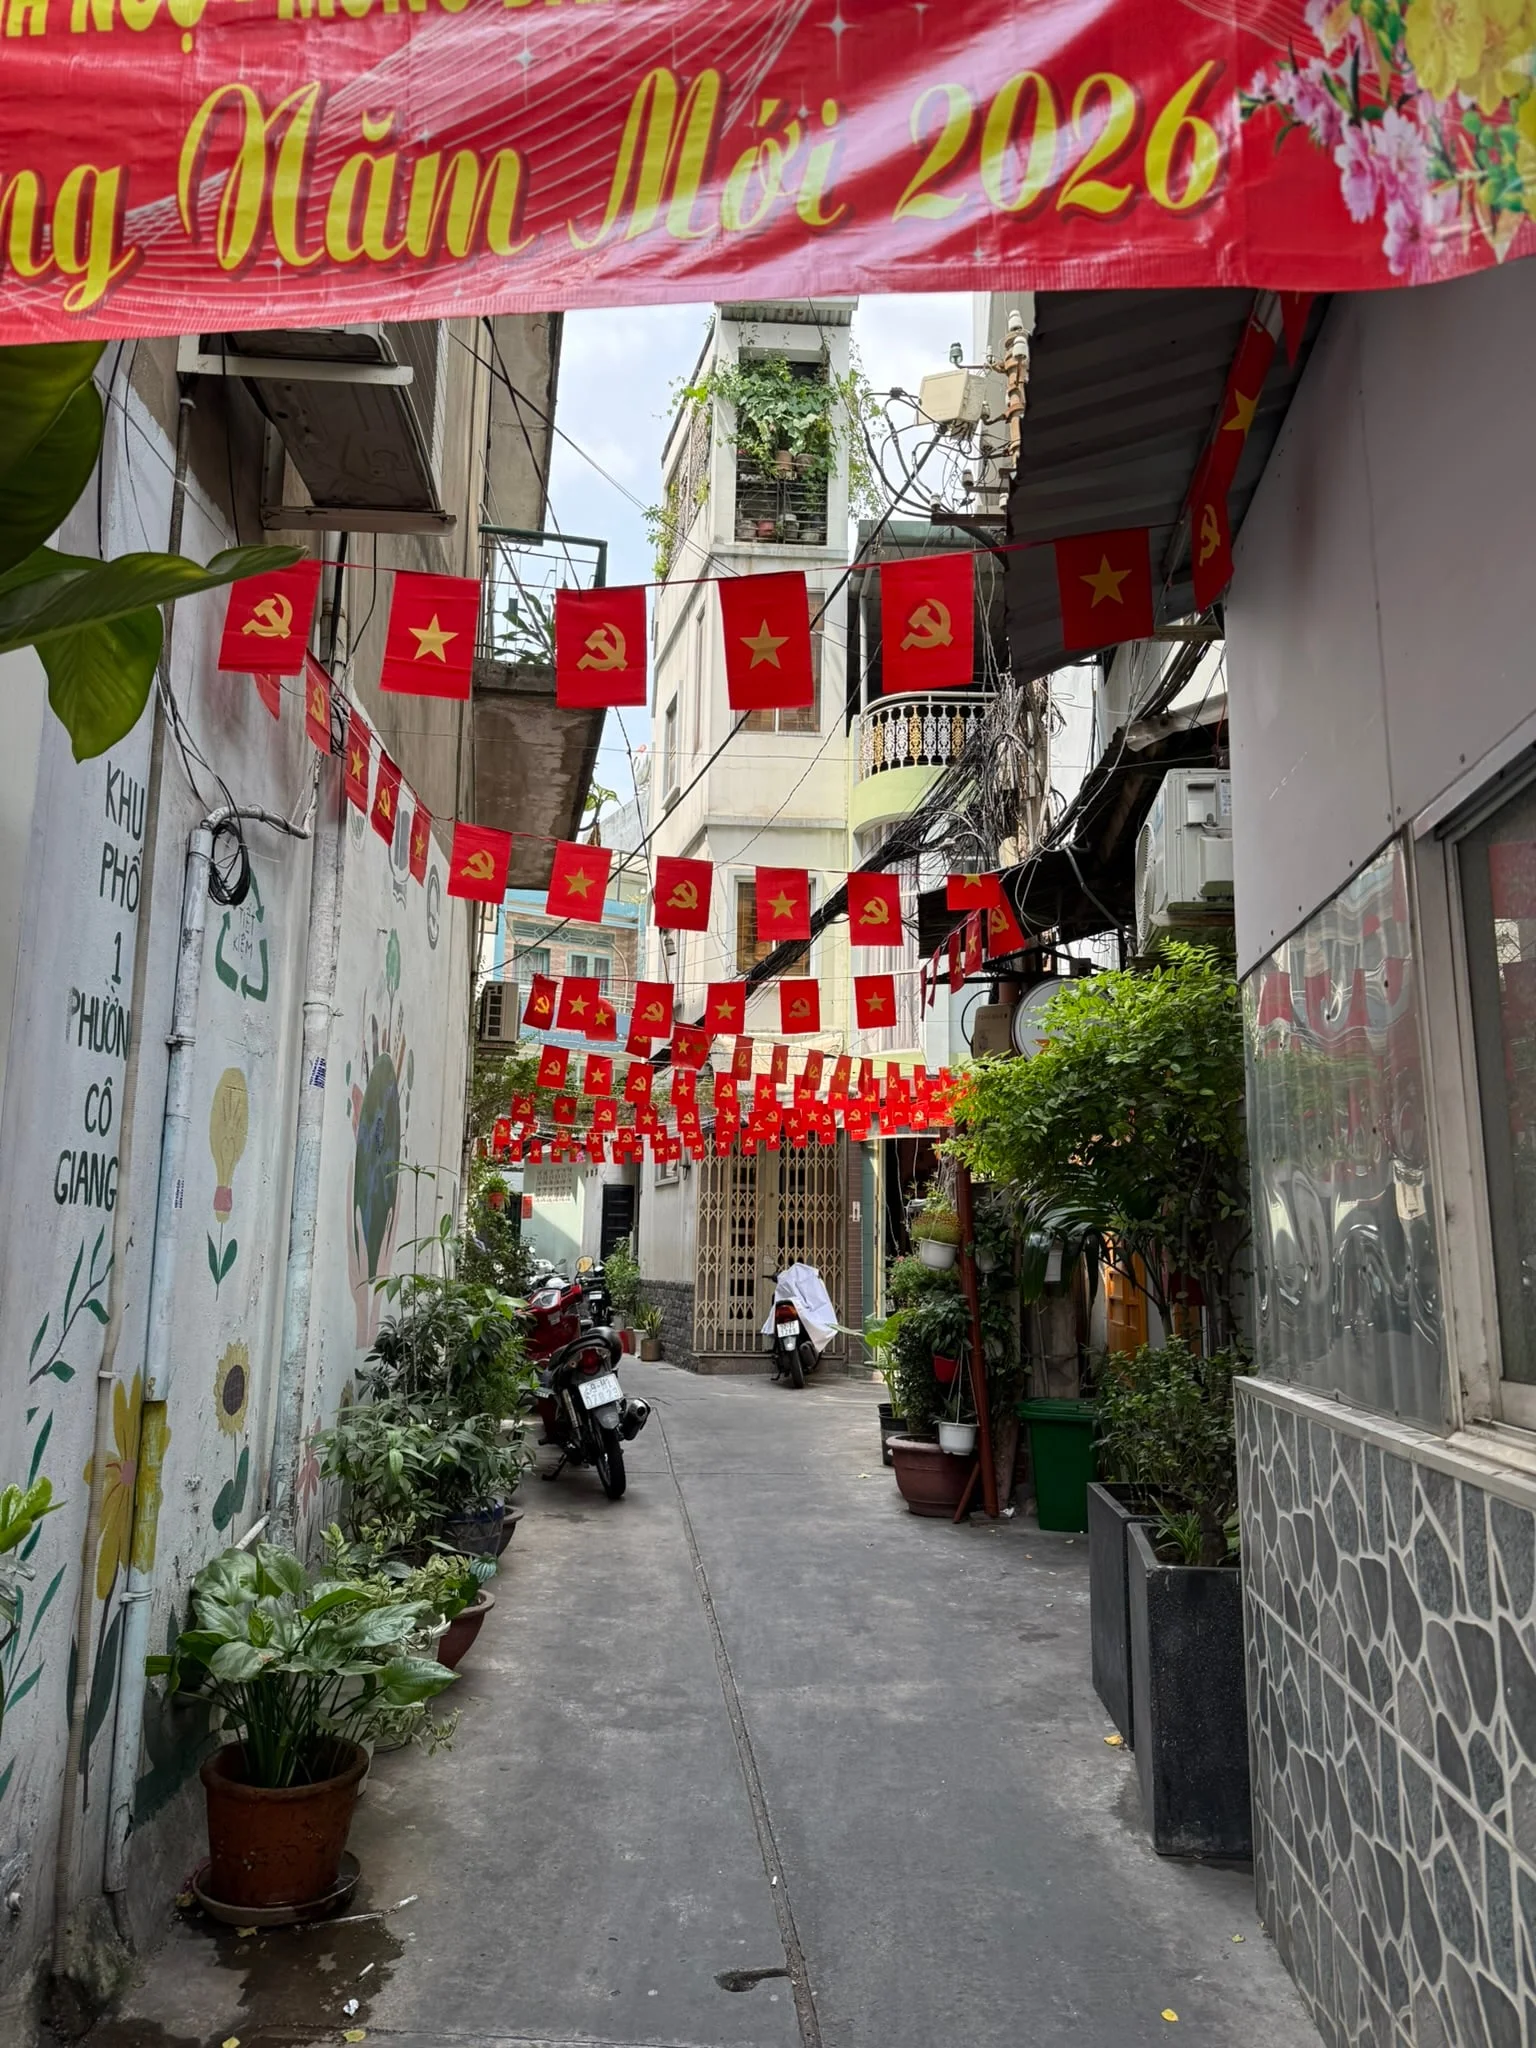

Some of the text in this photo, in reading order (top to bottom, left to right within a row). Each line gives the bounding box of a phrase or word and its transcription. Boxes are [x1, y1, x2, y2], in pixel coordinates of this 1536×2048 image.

[177, 81, 535, 270] Năm
[567, 67, 846, 250] Mới
[892, 60, 1220, 224] 2026
[105, 760, 145, 841] KHU
[99, 842, 143, 913] PHỐ
[112, 931, 122, 985] 1
[84, 1076, 112, 1137] CÔ
[54, 1150, 118, 1212] GIANG
